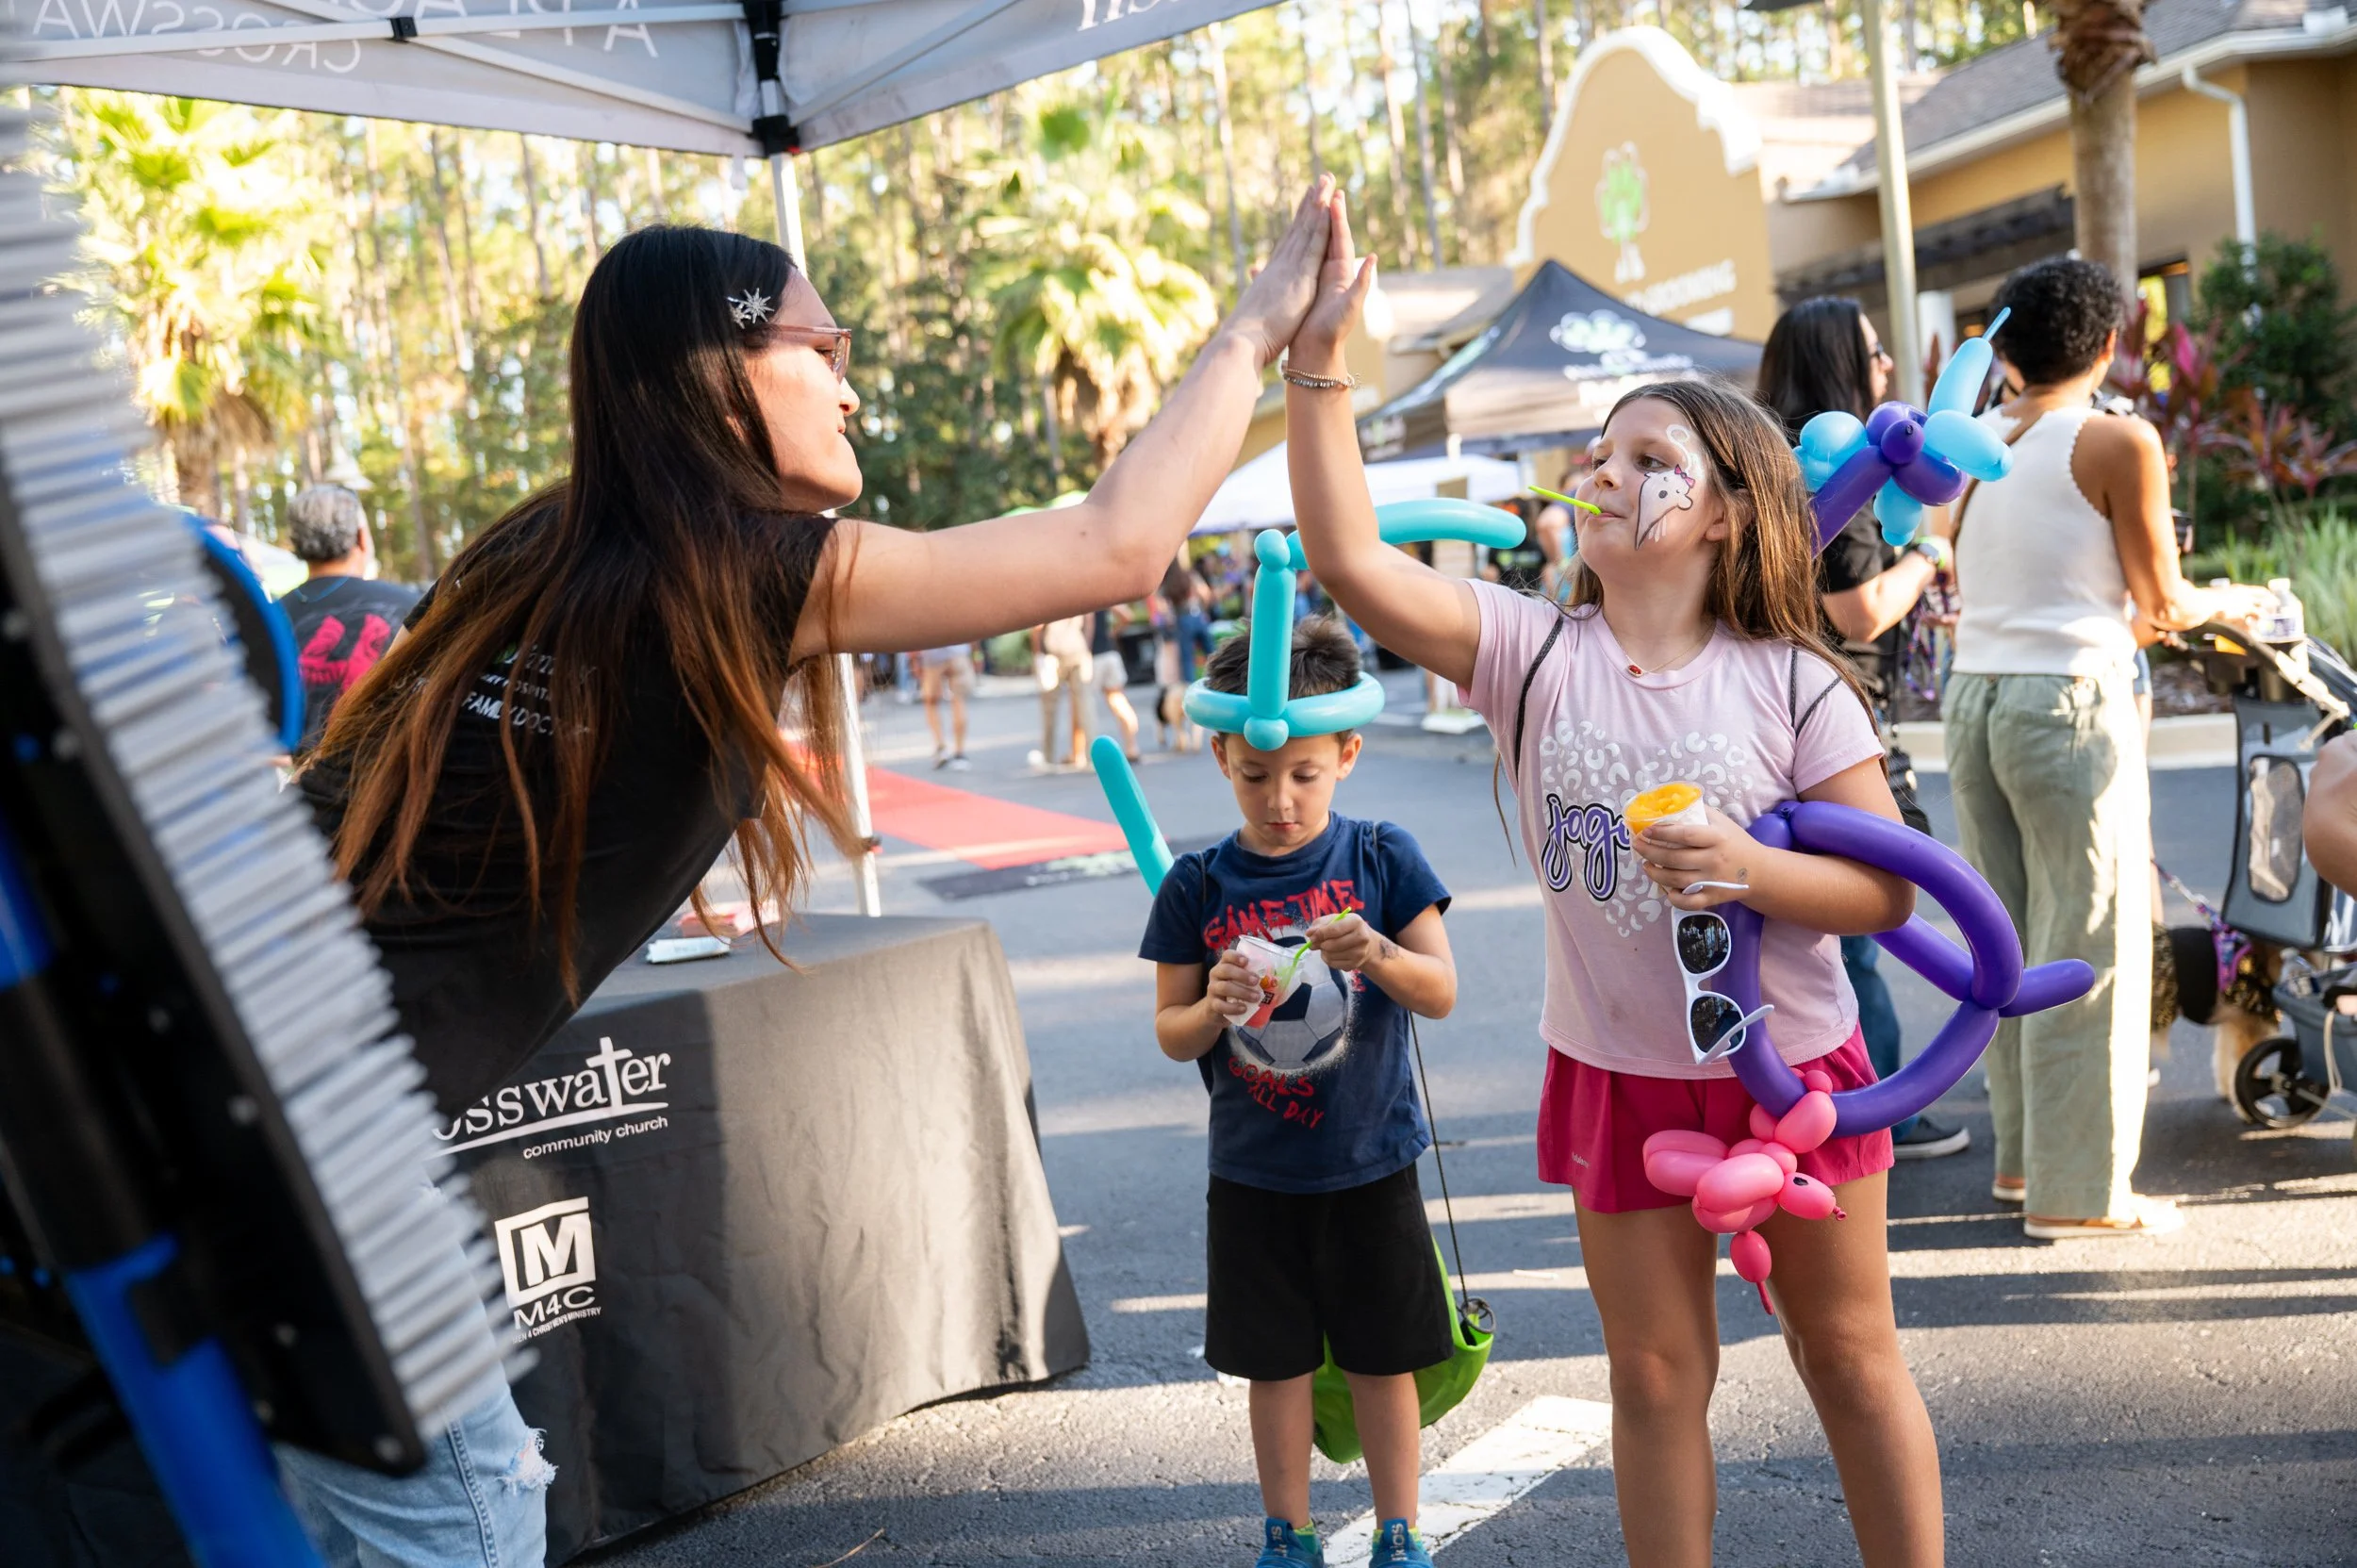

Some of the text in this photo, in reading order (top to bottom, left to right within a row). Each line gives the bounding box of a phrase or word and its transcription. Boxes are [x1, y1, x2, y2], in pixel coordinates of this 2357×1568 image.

[1202, 879, 1366, 950] GAME TIME
[1228, 1056, 1315, 1098] GOALS
[1247, 1081, 1326, 1130] ALL DAY
[522, 1114, 669, 1160] community church
[513, 1285, 596, 1329] M4C
[568, 1306, 602, 1321] MINISTRY
